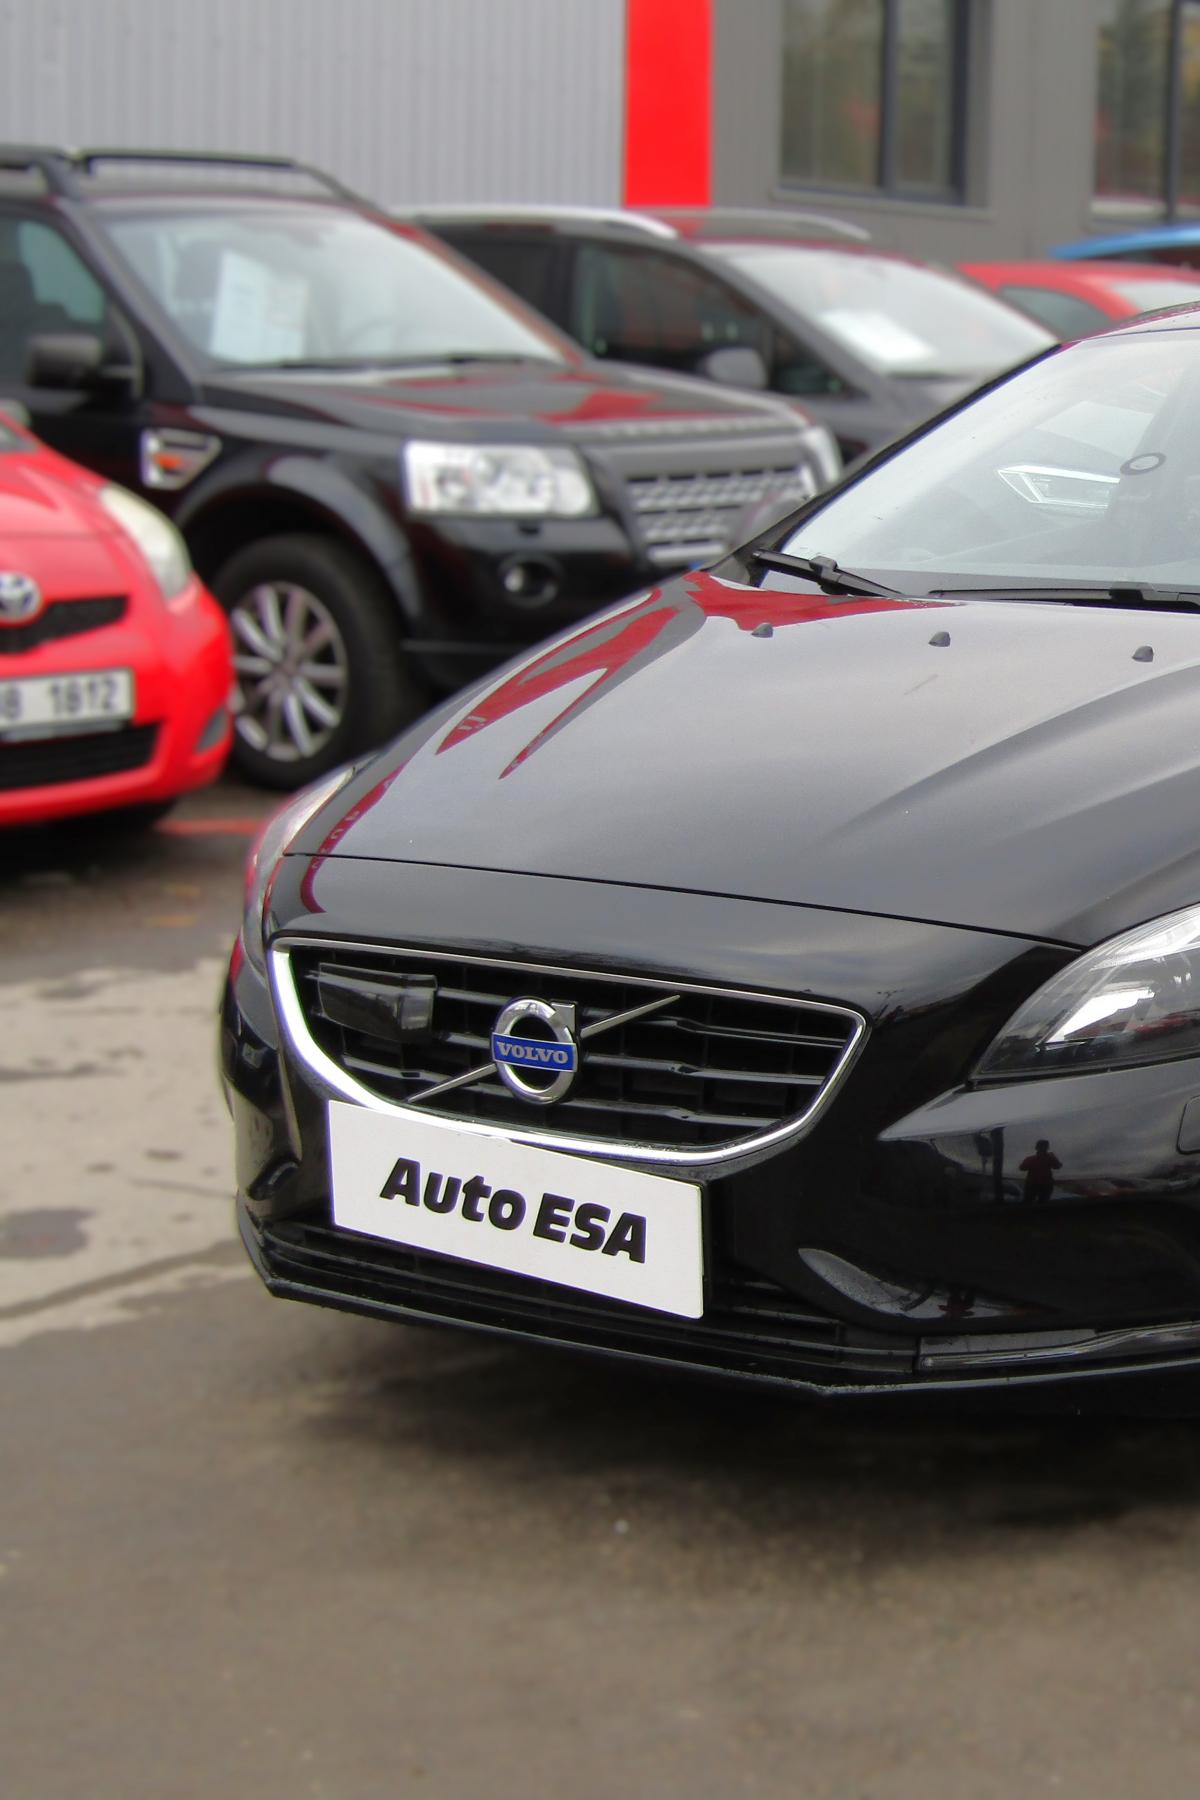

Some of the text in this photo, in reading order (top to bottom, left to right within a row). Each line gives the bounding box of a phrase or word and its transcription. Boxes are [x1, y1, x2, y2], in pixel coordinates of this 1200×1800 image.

[496, 1041, 569, 1064] VOLVO
[379, 1157, 647, 1263] Auto ESA
